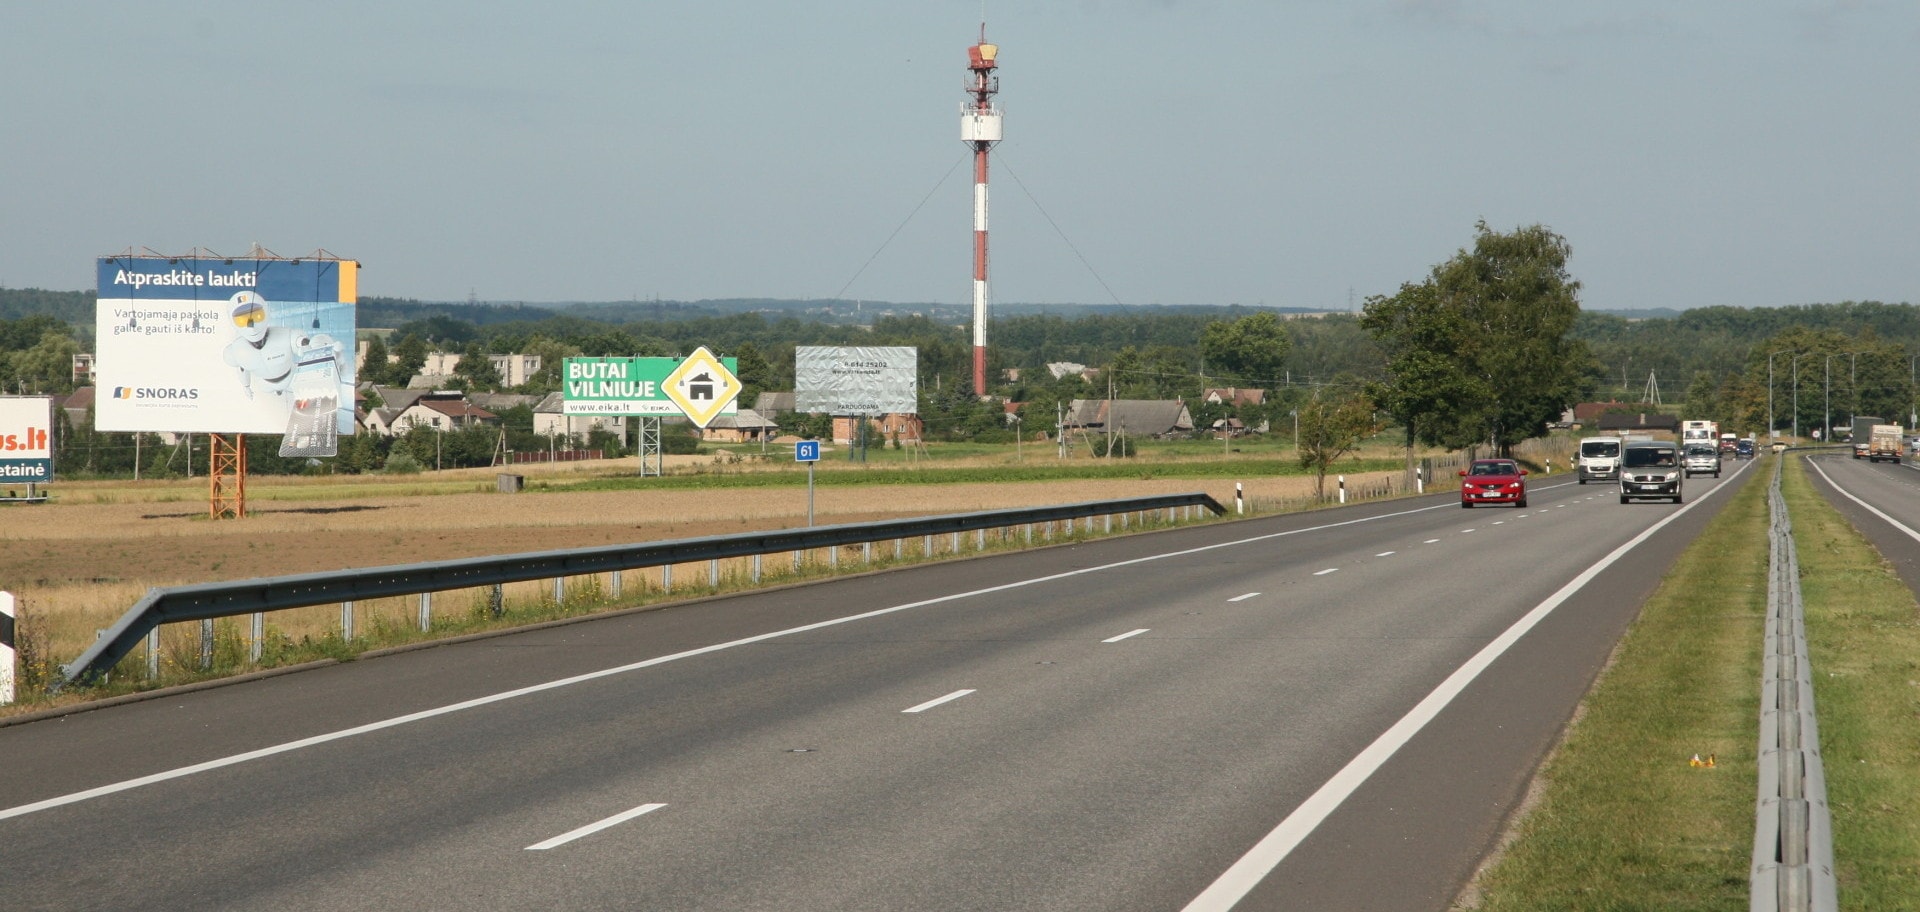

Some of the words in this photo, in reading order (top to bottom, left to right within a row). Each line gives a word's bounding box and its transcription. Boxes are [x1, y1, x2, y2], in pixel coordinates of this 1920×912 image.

[114, 269, 204, 290] Atpraskite
[208, 270, 257, 287] laukti
[145, 324, 172, 336] gauti
[174, 324, 182, 334] iš
[569, 362, 627, 379] BUTAI
[135, 387, 199, 399] SNORAS
[568, 381, 656, 398] VILNIUJE
[570, 403, 630, 412] www.eika.lt
[800, 445, 812, 457] 61
